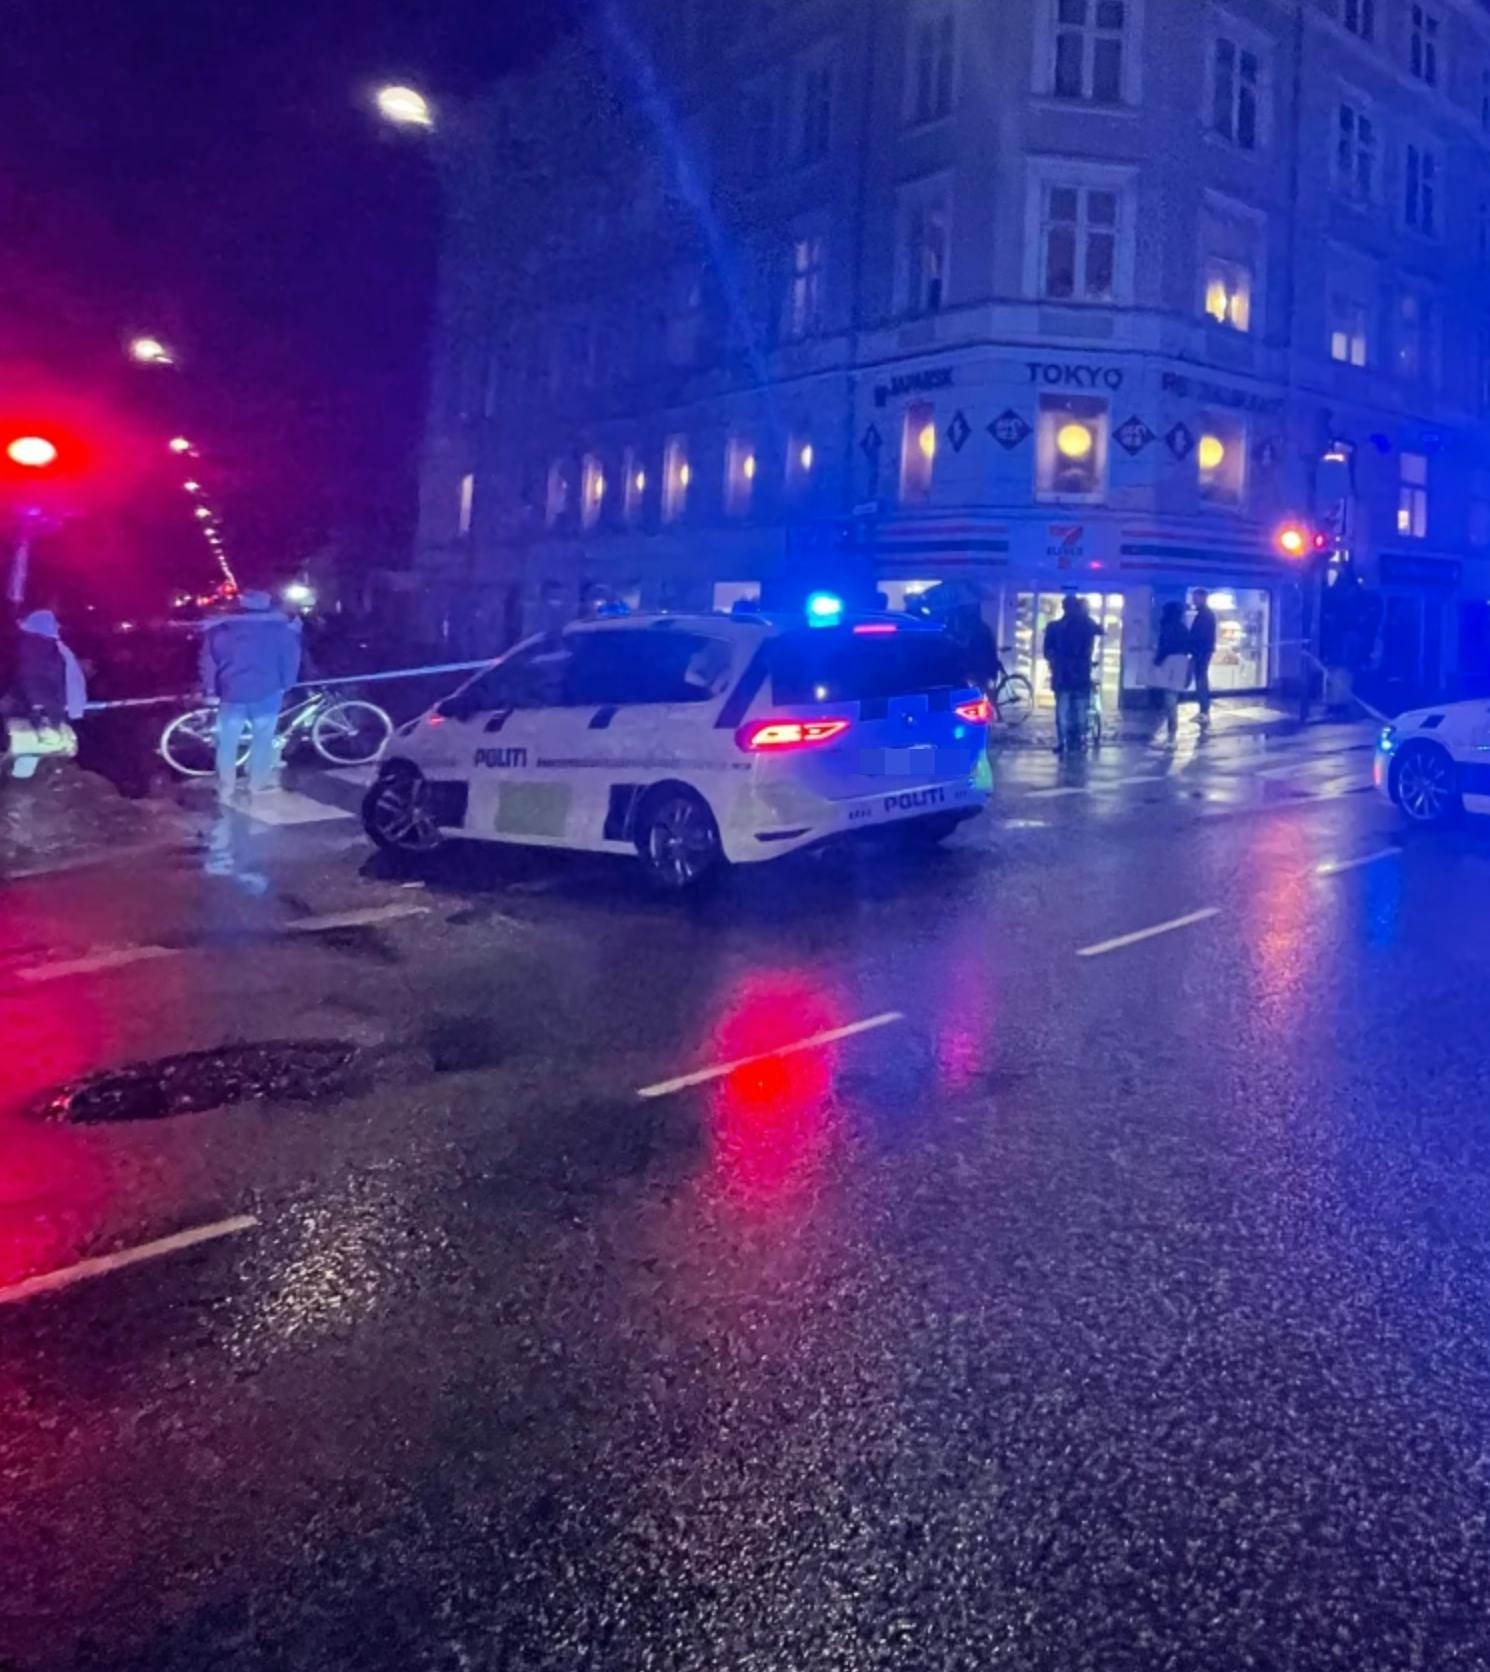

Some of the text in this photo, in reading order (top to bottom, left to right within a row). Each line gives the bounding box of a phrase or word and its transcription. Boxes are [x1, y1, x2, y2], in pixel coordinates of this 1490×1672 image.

[1025, 362, 1123, 391] TOKYO
[475, 748, 528, 769] POLITI
[884, 787, 945, 813] POLITI
